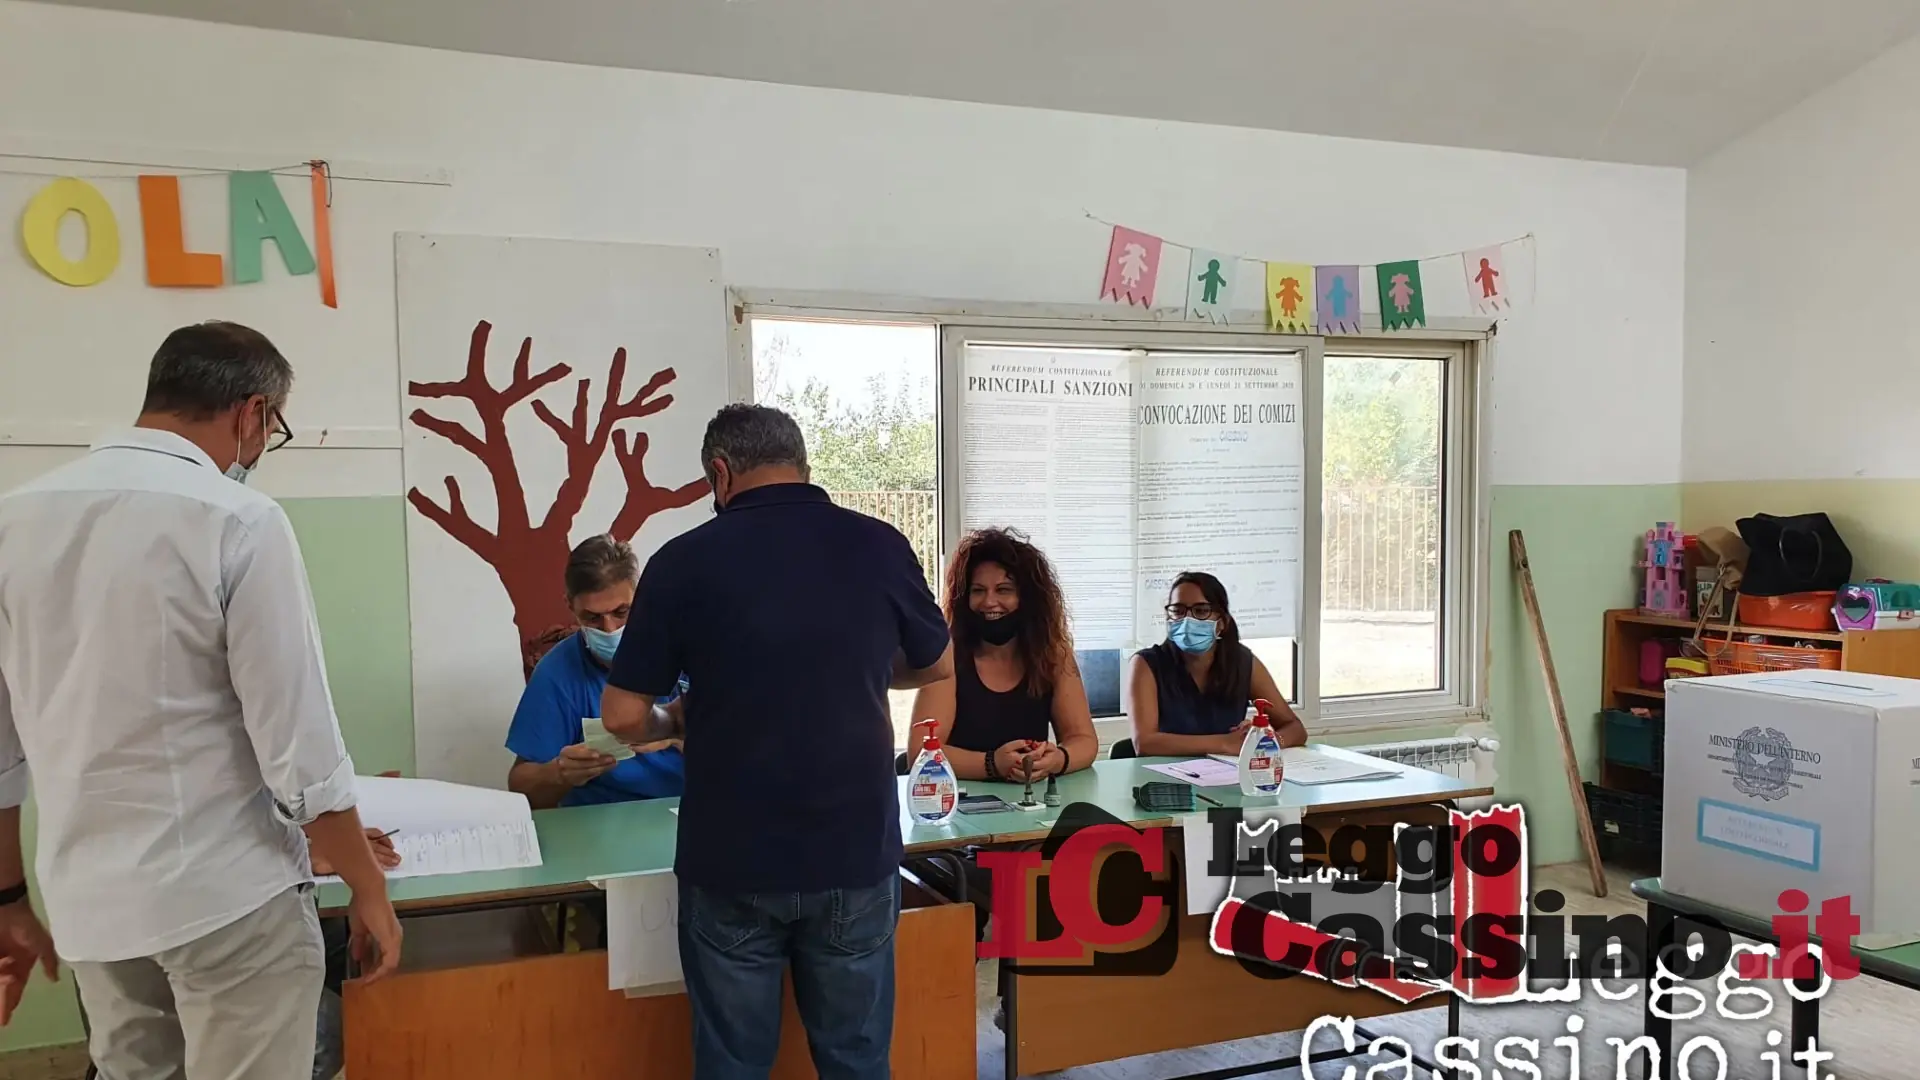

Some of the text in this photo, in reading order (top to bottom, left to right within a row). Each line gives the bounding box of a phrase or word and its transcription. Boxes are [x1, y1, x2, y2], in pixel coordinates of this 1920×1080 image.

[991, 364, 1113, 377] REFERENDUM COSTITUZIONALE
[1155, 367, 1278, 376] REFERENDUM COSTITUZIONALE
[968, 376, 1133, 397] PRINCIPALI SANZIONI
[1233, 404, 1252, 424] DEI
[1258, 404, 1296, 424] COMIZI
[1708, 733, 1755, 752] MINISTERO
